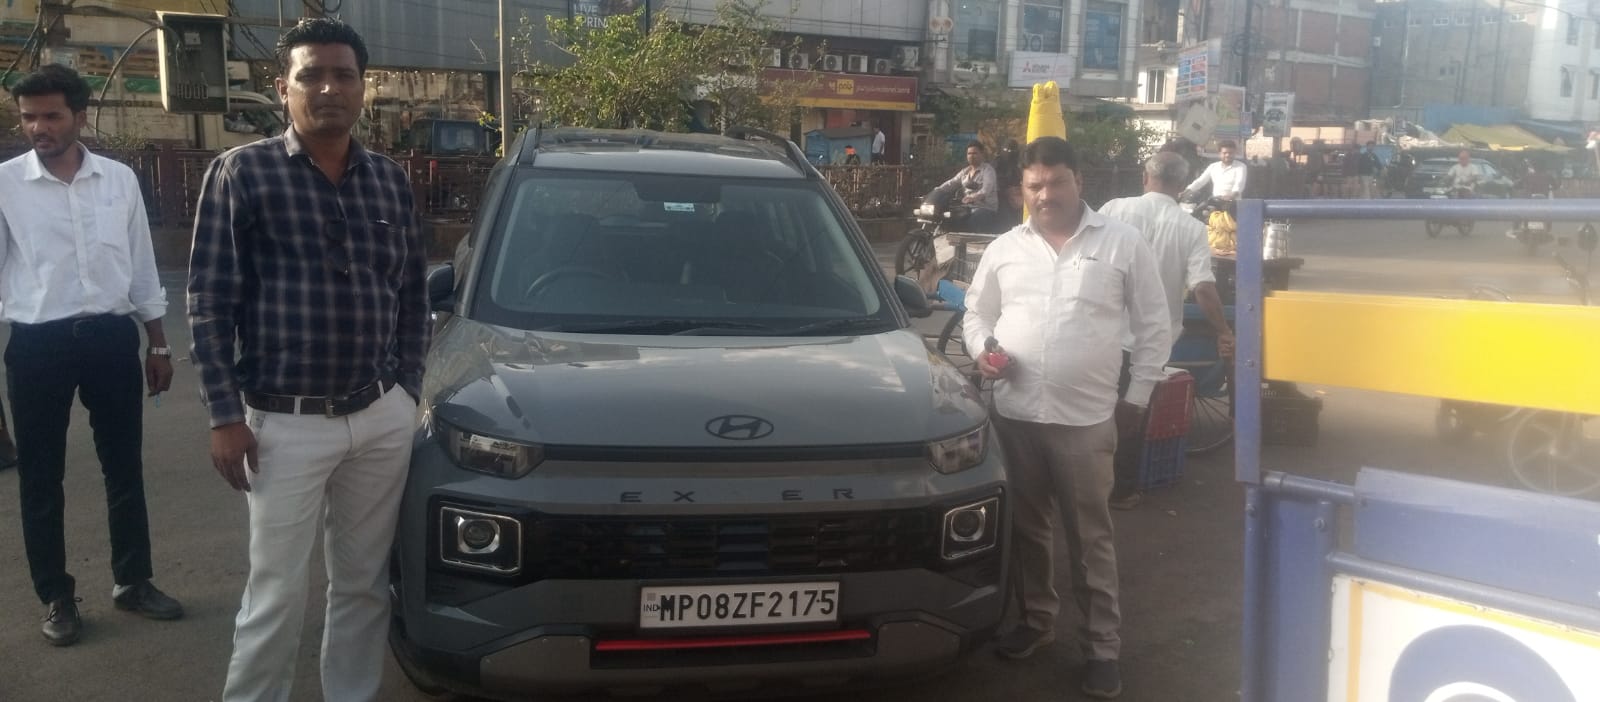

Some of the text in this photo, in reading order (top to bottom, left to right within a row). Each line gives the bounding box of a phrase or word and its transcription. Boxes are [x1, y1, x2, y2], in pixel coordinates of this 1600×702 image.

[573, 4, 599, 16] LIVE
[619, 487, 855, 504] EXER
[643, 603, 658, 612] IND
[659, 589, 837, 622] MP08ZF2175
